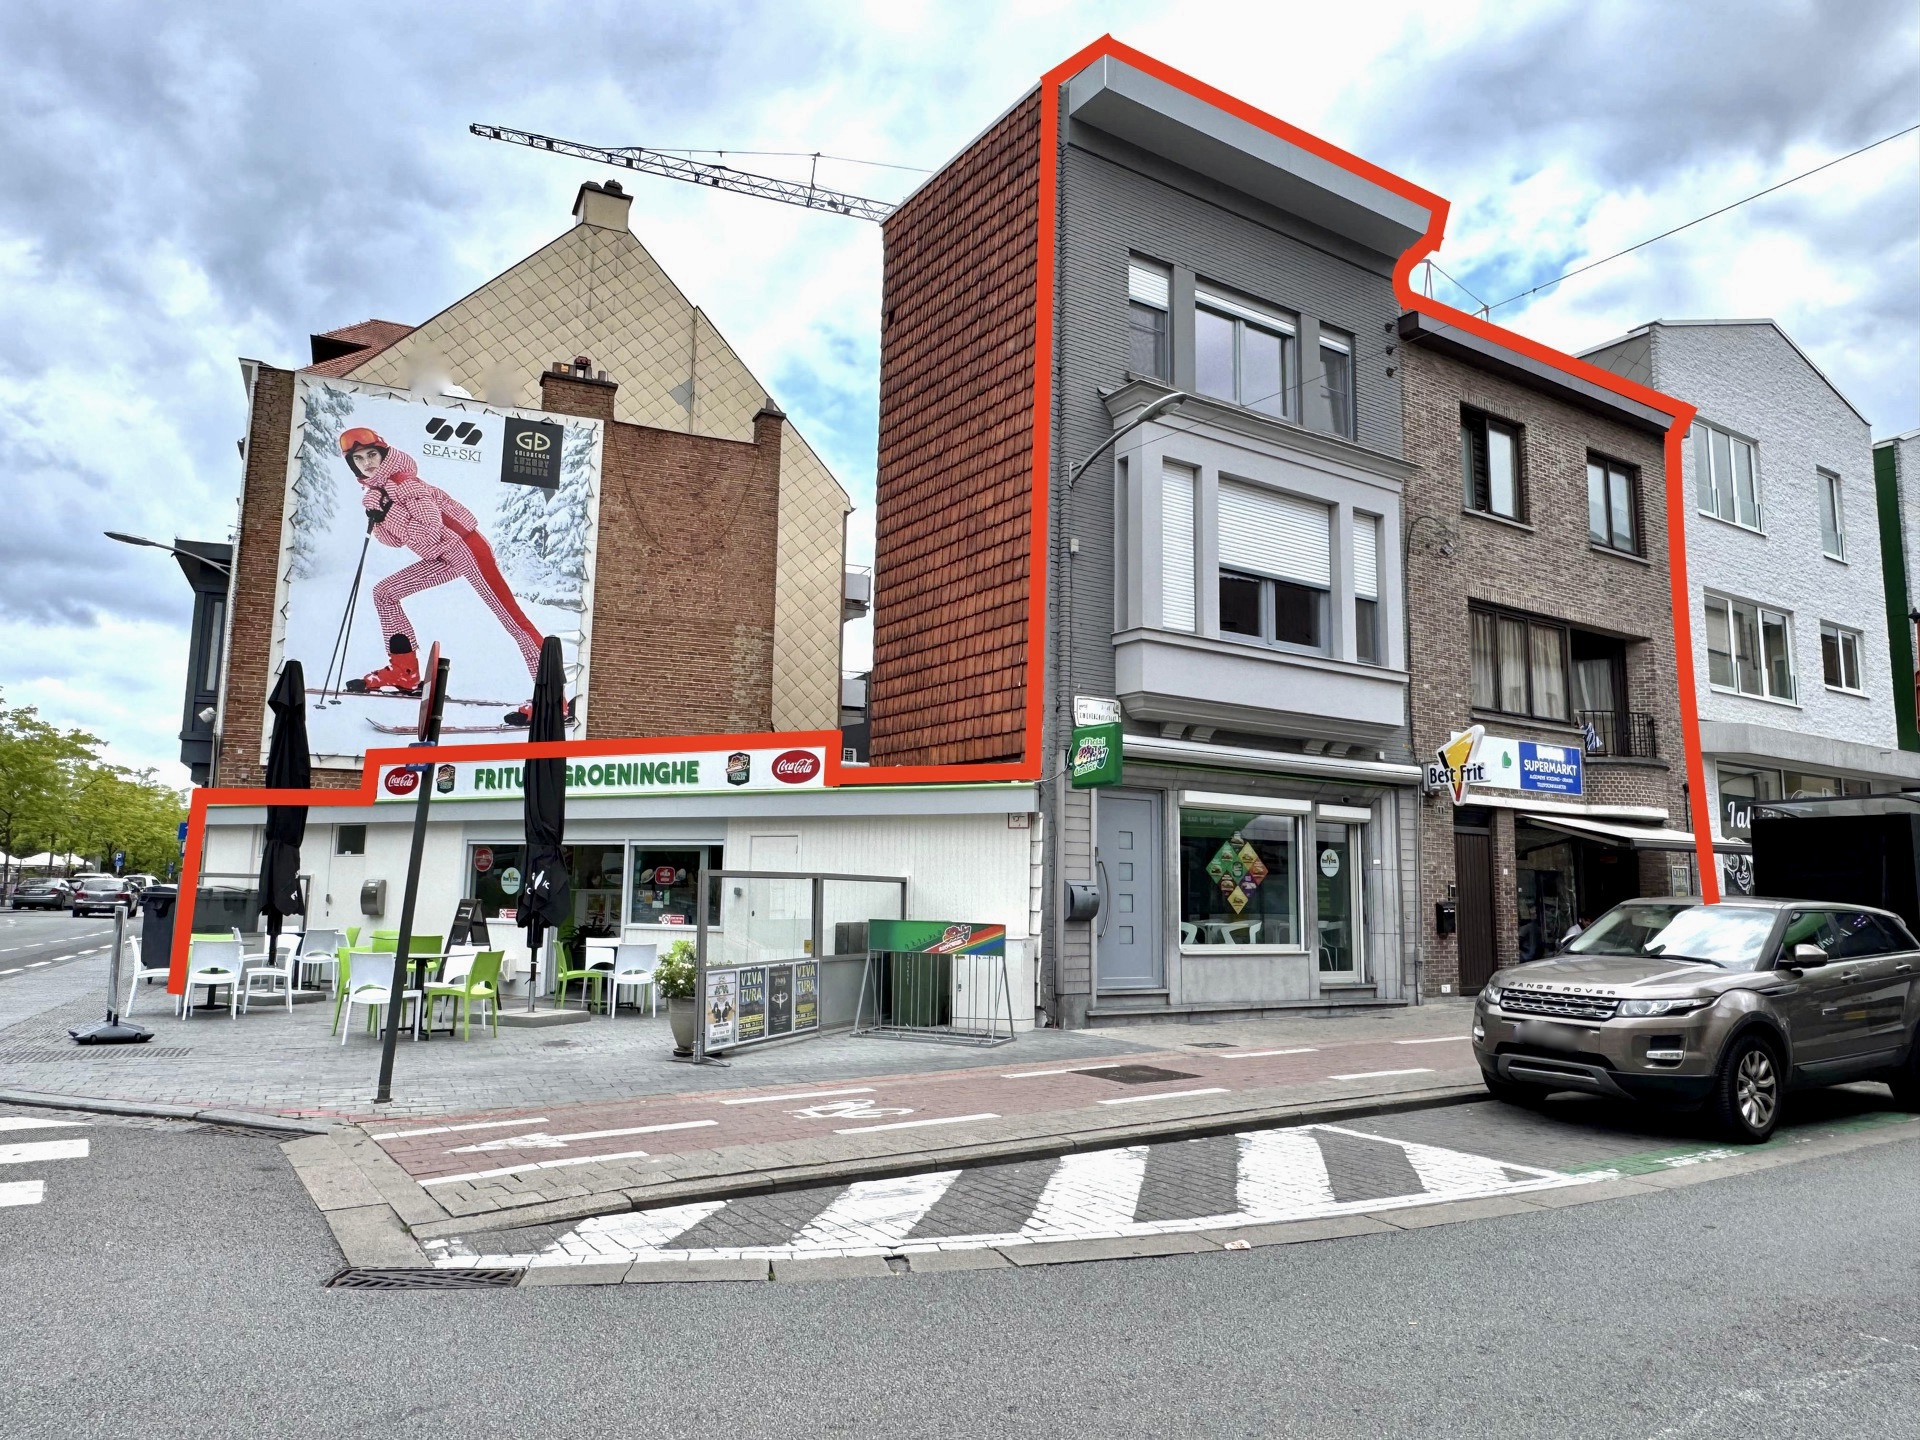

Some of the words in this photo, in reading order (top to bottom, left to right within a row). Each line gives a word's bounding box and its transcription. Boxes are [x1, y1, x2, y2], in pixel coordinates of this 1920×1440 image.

[474, 767, 525, 790] FRITU
[565, 760, 699, 787] GROENINGHE
[1429, 767, 1456, 784] Best
[1460, 764, 1484, 780] Frit
[1523, 759, 1577, 776] SUPERMARKT
[741, 971, 763, 986] VIVA
[796, 964, 816, 978] VIVA
[796, 979, 815, 993] TURA
[1508, 982, 1553, 990] RANGE
[1562, 986, 1616, 996] ROVER
[740, 987, 762, 1003] TURA
